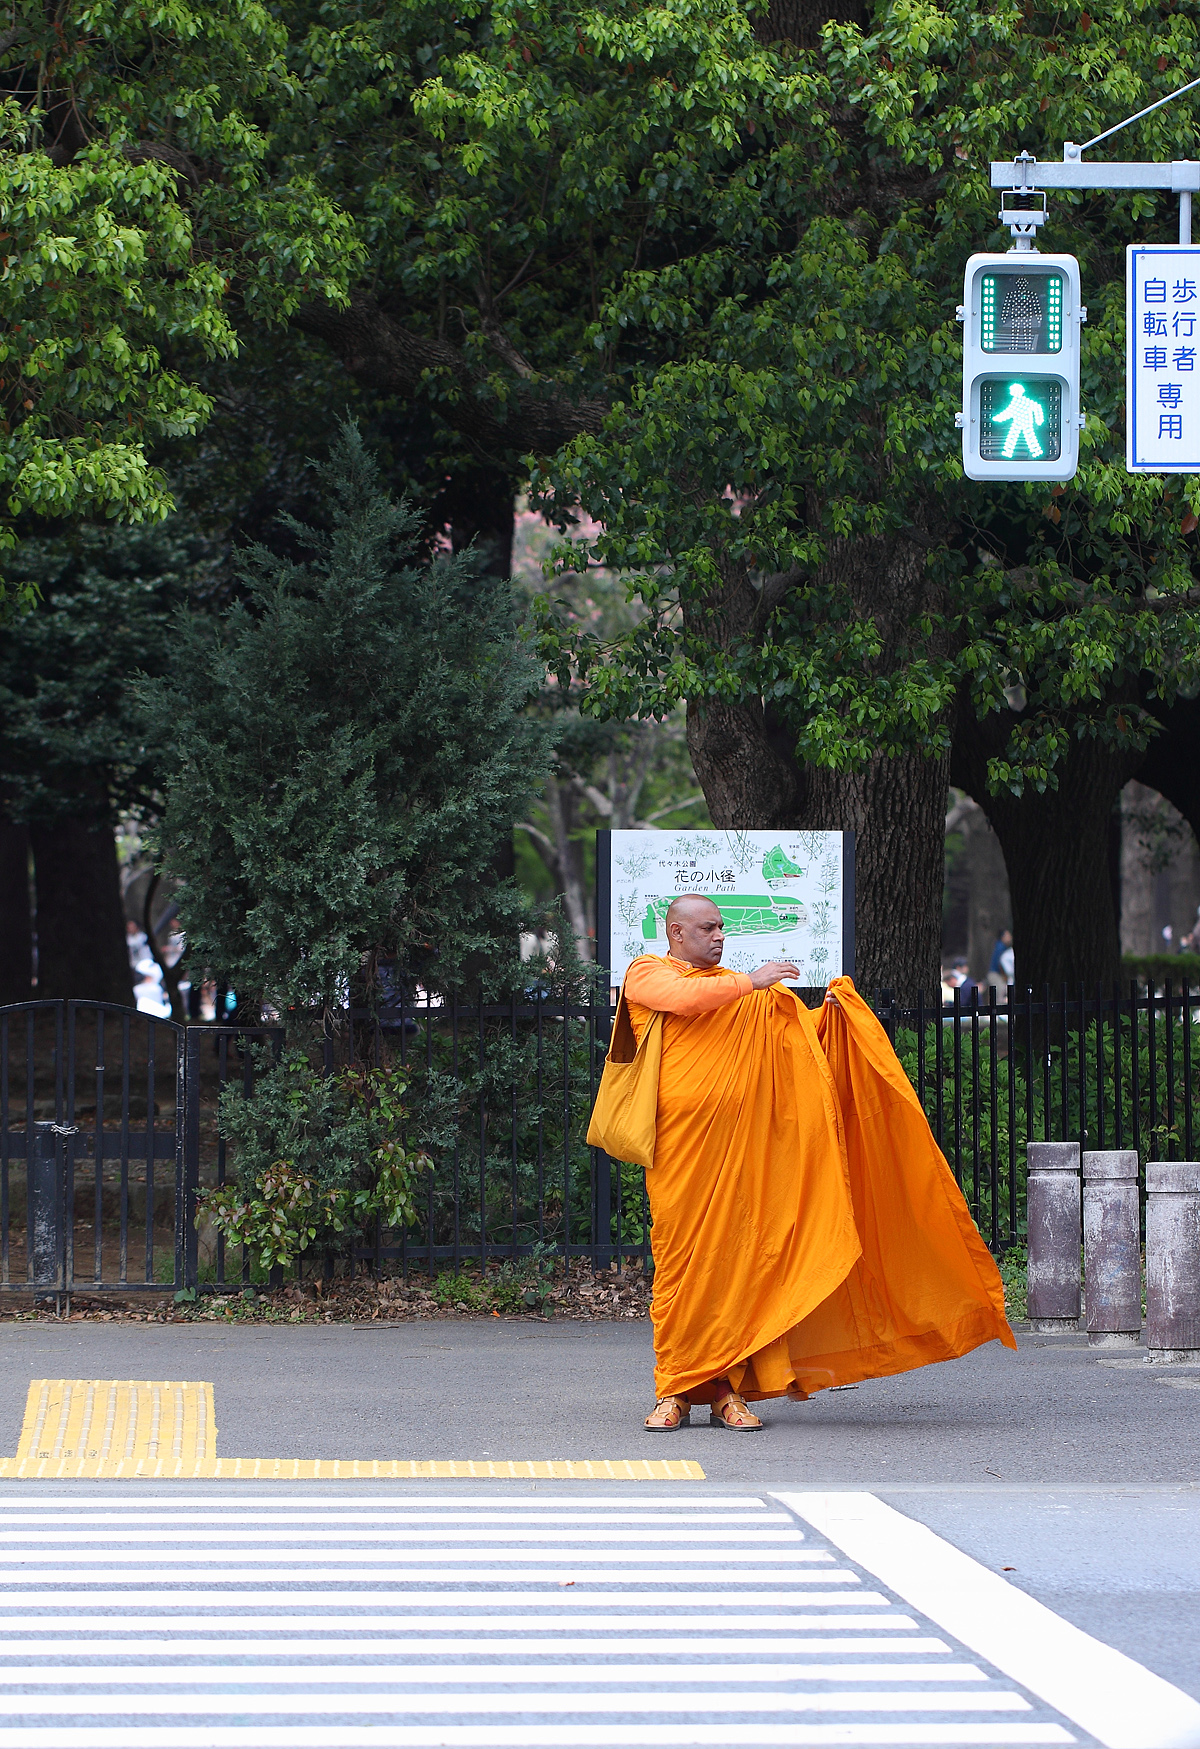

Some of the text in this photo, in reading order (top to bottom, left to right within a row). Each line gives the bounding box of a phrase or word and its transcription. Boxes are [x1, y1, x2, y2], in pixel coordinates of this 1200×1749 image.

[1142, 277, 1168, 372] 自転車
[1172, 277, 1197, 372] 歩行者
[1156, 382, 1184, 440] 専用
[658, 860, 697, 868] 代々木公園
[674, 869, 736, 883] 花の小径
[674, 884, 736, 892] Garden Path
